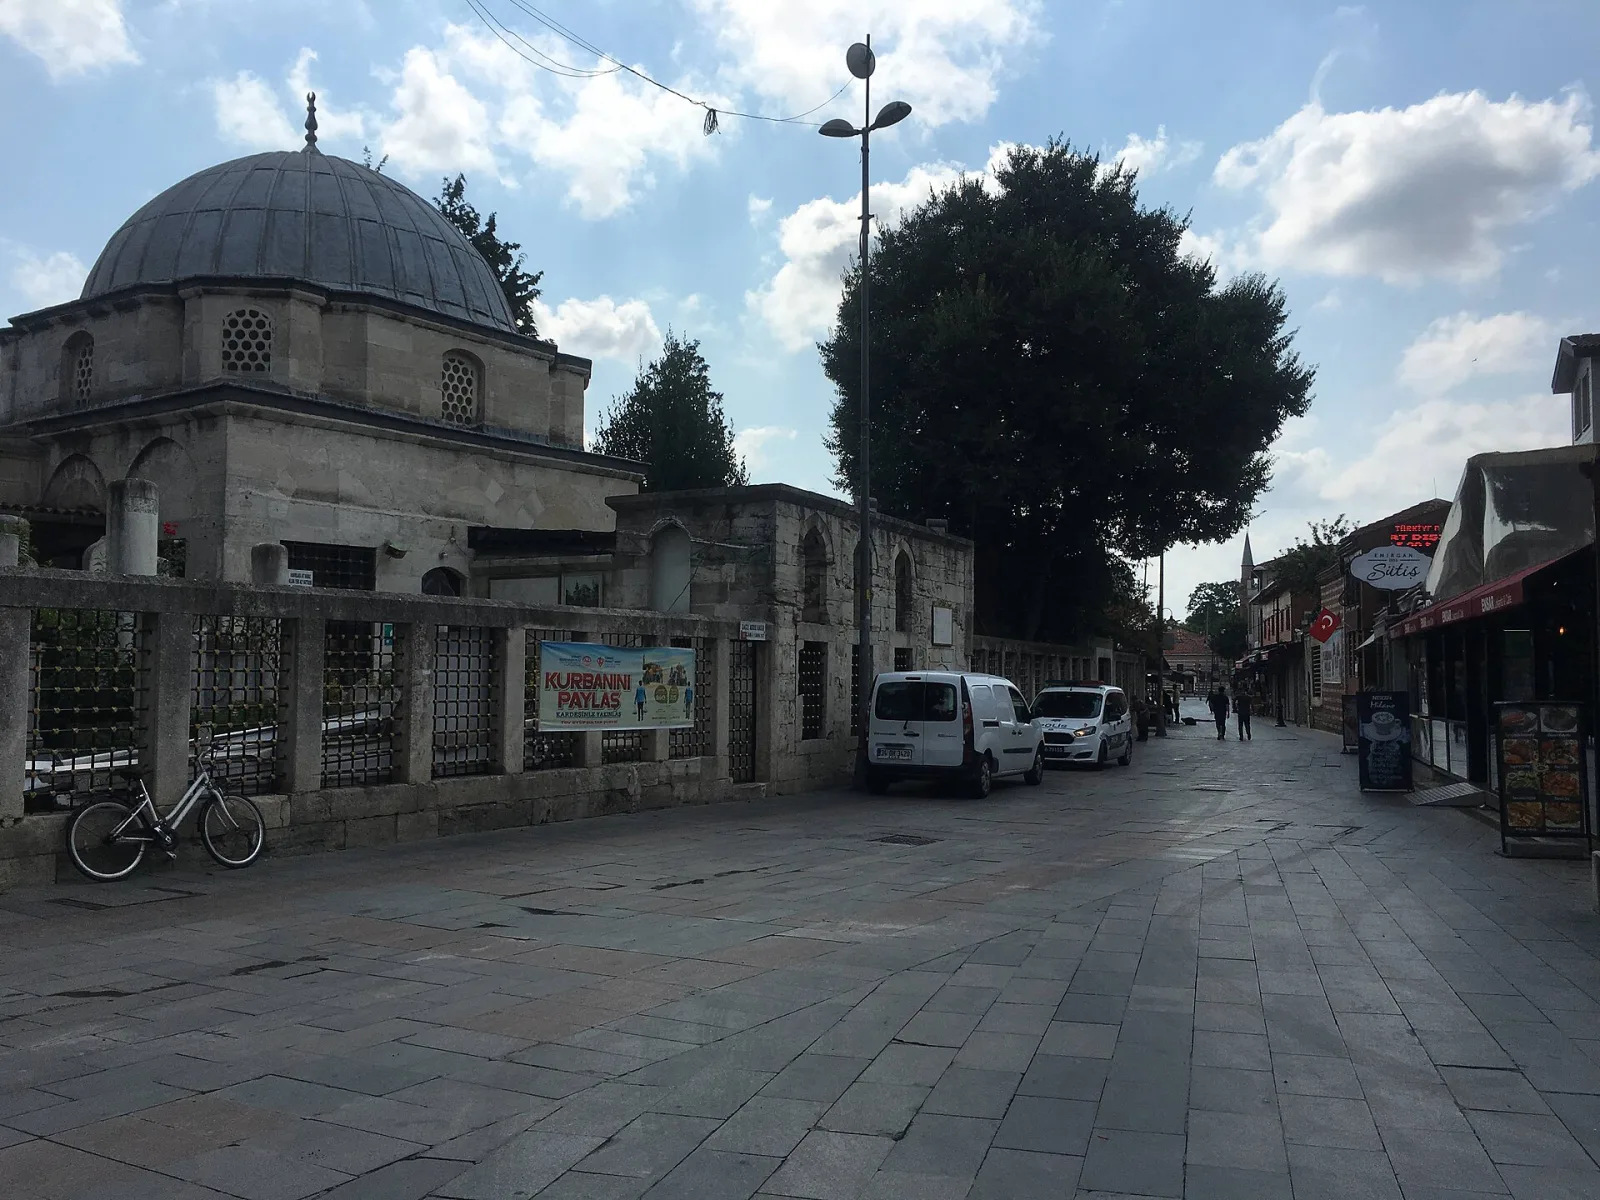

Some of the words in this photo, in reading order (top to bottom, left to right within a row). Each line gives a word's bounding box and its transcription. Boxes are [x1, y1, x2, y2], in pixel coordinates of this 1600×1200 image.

[1366, 563, 1421, 581] Sütiş
[545, 671, 632, 691] KURBANINI
[558, 691, 622, 711] PAYLAŞ
